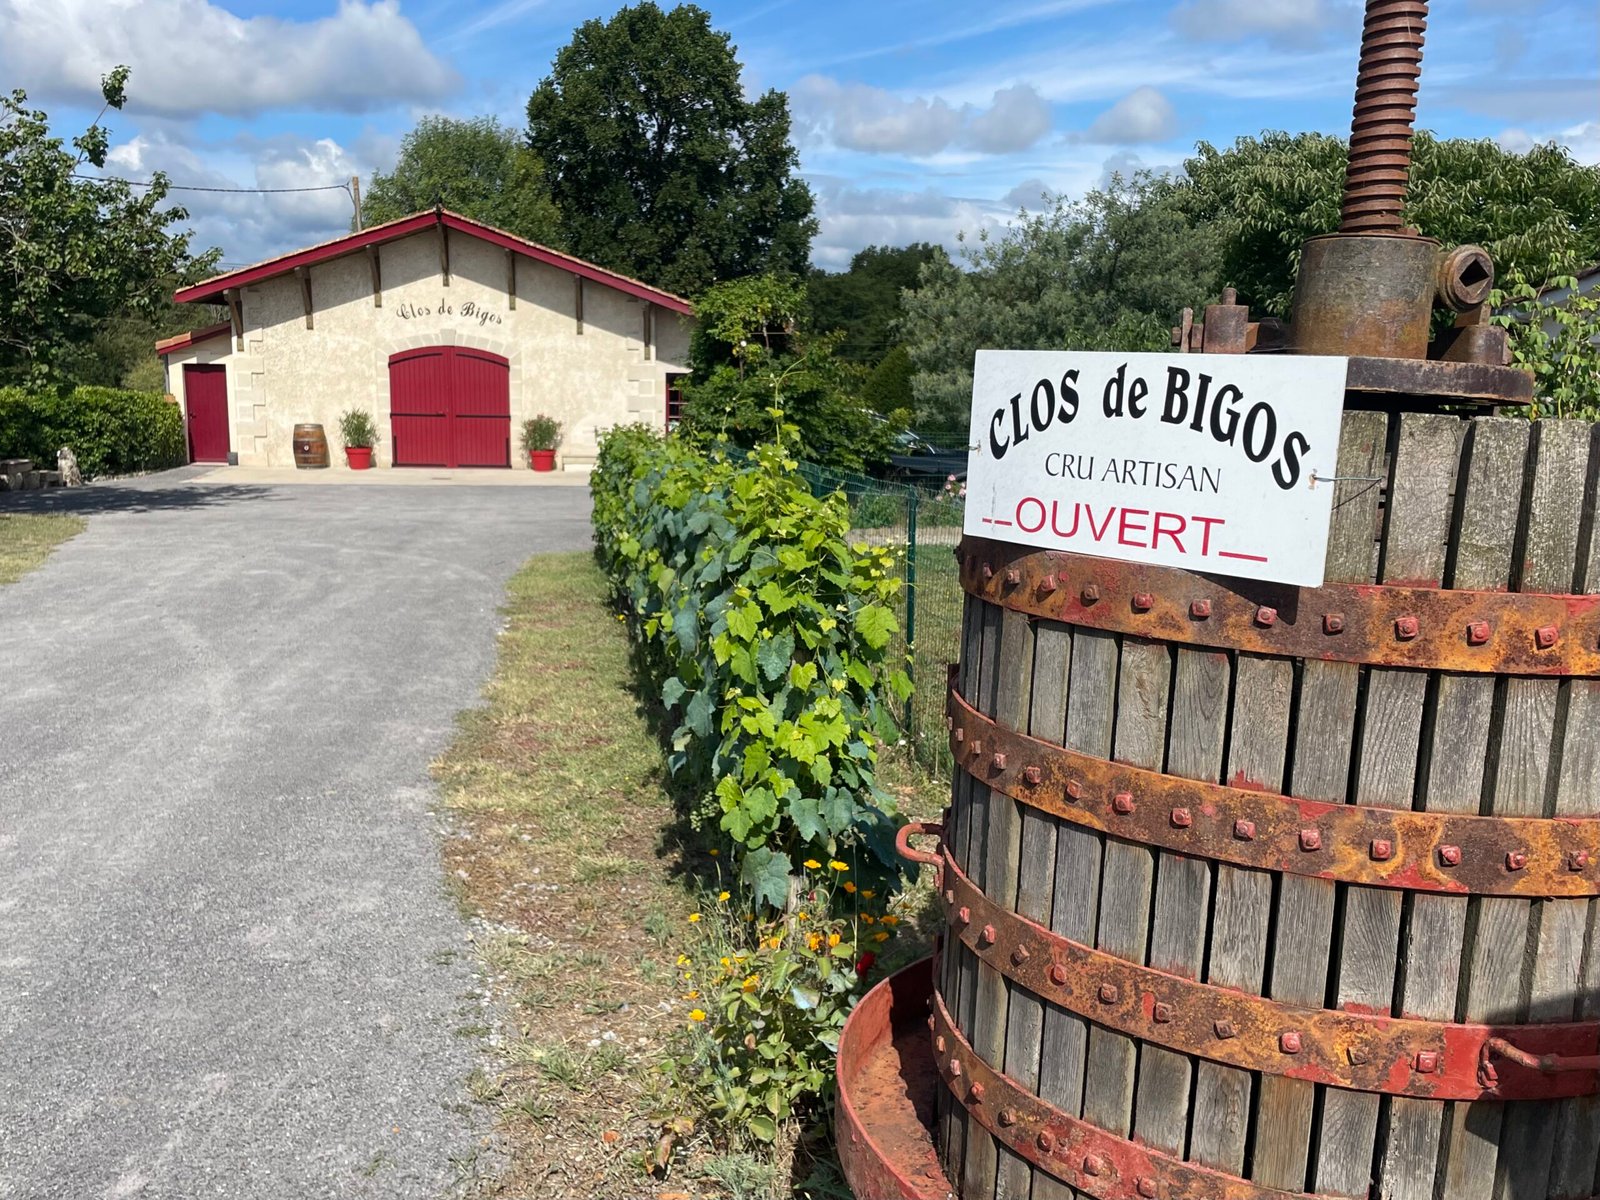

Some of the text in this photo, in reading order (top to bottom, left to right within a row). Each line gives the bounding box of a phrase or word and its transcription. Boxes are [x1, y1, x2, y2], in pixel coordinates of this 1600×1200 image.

[396, 297, 502, 326] Clos de Bigos
[989, 362, 1311, 490] CLOS de BIGOS
[1045, 452, 1222, 494] CRU ARTISAN
[1015, 496, 1226, 557] OUVERT
